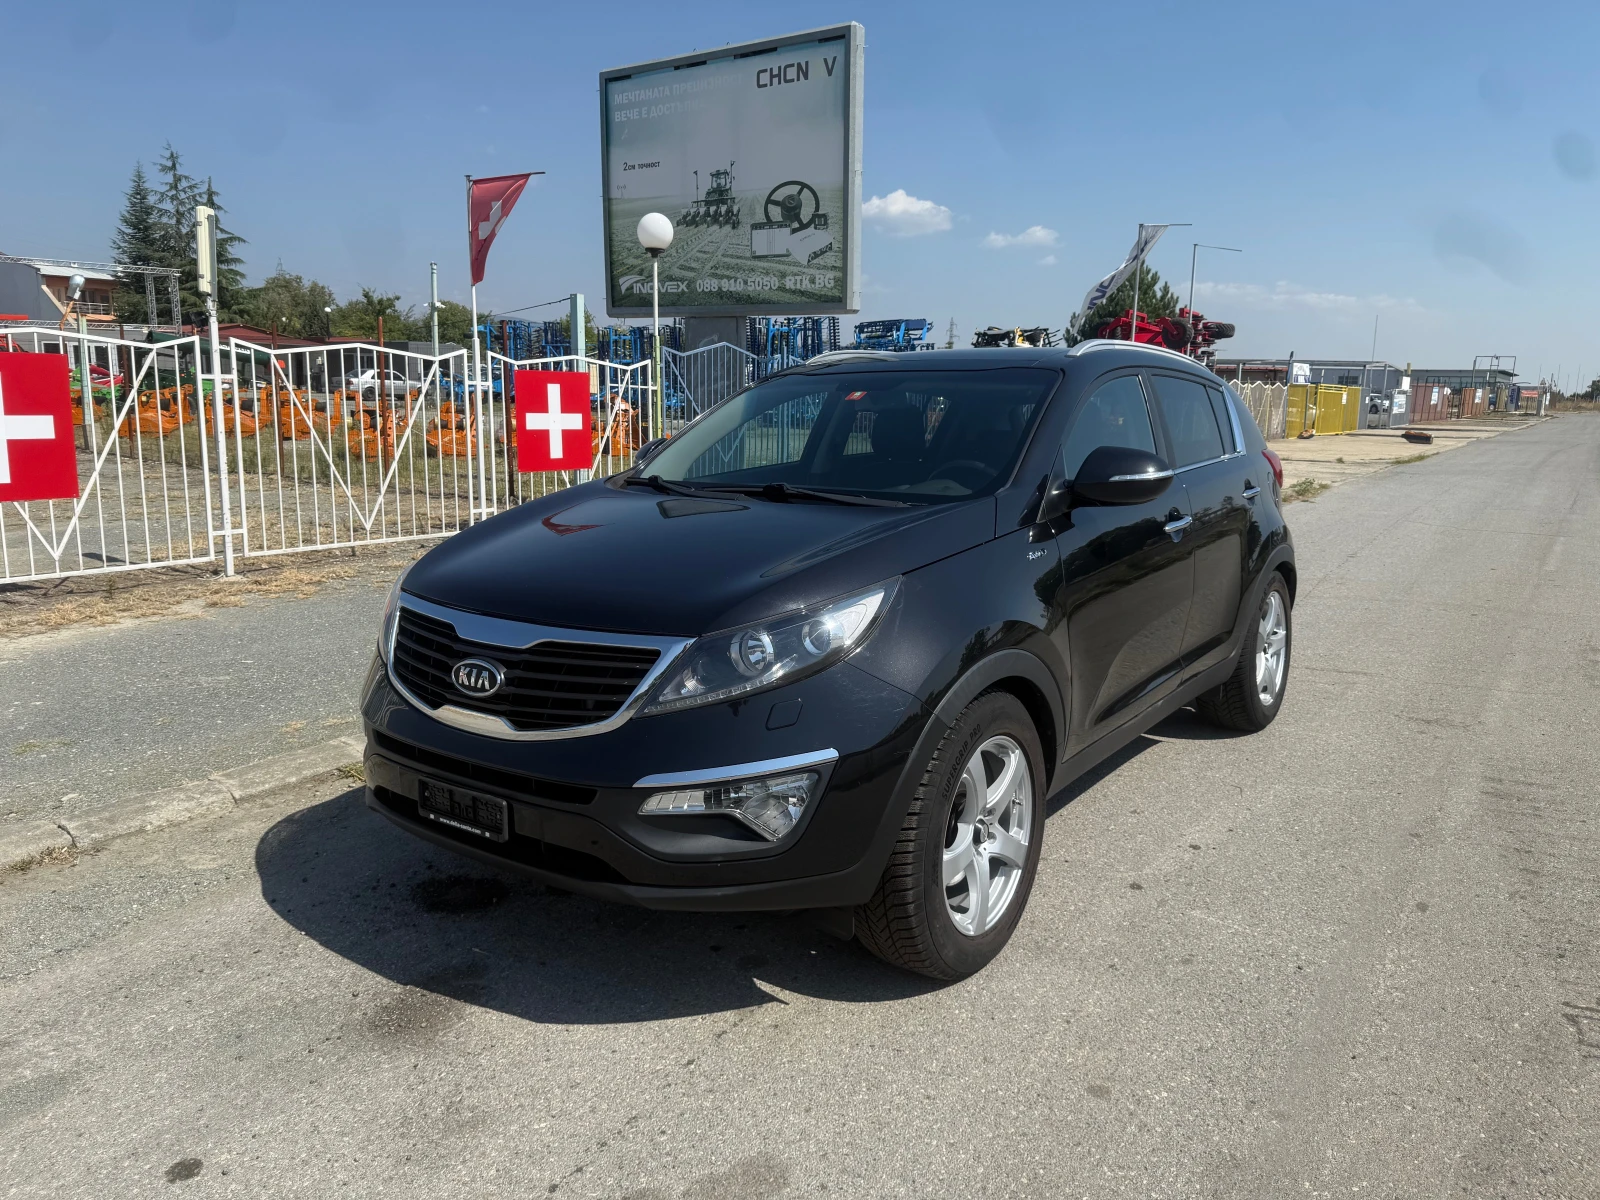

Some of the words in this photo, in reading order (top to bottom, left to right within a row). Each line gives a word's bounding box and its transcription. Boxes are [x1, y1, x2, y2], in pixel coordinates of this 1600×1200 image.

[756, 60, 809, 89] CHCN
[823, 55, 837, 77] V
[614, 85, 671, 105] МЕЧТАНАТА
[614, 108, 640, 122] ВЕЧЕ
[641, 106, 648, 118] Е
[696, 279, 718, 292] 088
[720, 278, 744, 292] 910
[747, 277, 779, 291] 5050
[784, 273, 835, 289] RTK.BG
[458, 665, 490, 690] KIA
[941, 740, 969, 800] SUPERGRIP
[969, 723, 982, 740] PRO
